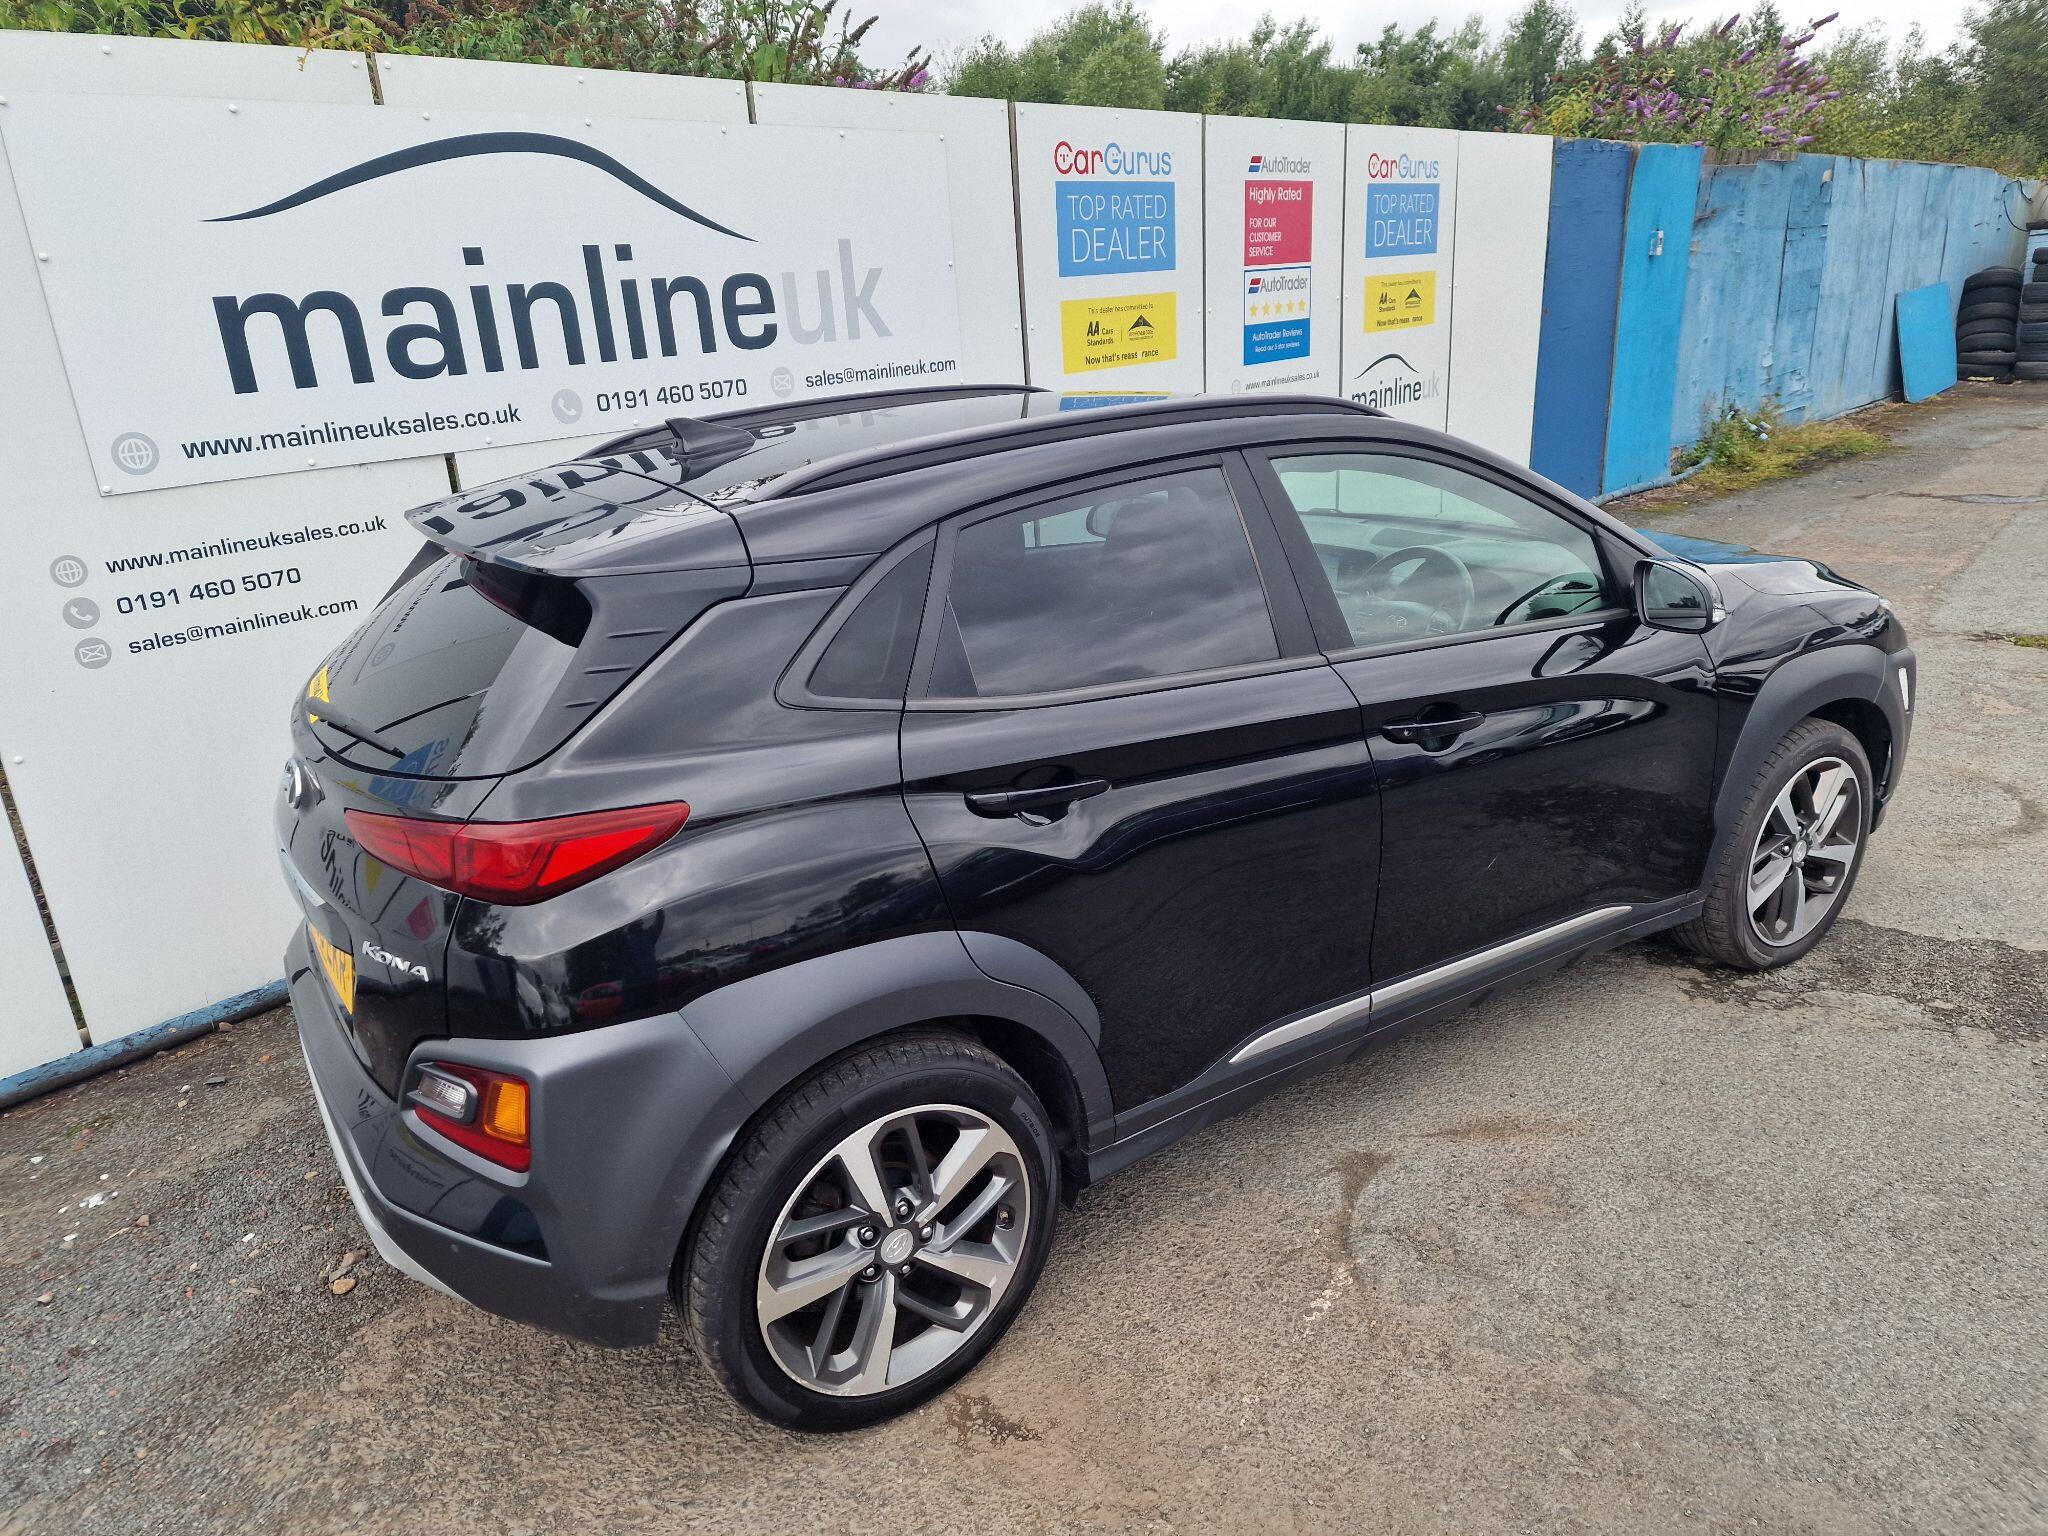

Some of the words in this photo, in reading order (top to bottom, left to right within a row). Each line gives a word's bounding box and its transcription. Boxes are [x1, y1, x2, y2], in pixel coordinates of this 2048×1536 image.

[1054, 140, 1172, 176] CarGurus
[1261, 156, 1312, 174] AutoTrader
[1368, 153, 1440, 179] CarGurus
[1067, 194, 1106, 220] TOP
[1111, 194, 1167, 220] RATED
[1249, 186, 1276, 204] Highly
[1278, 186, 1302, 201] Rated
[1373, 194, 1398, 215] TOP
[1400, 193, 1435, 214] RATED
[1249, 217, 1262, 228] FOR
[1263, 217, 1277, 228] OUR
[1374, 218, 1433, 247] DEALER
[1072, 226, 1167, 263] DEALER
[1249, 231, 1282, 243] CUSTOMER
[1249, 246, 1274, 257] SERVICE
[1260, 276, 1308, 293] AutoTrader
[212, 237, 893, 394] mainlineuk
[1086, 321, 1100, 337] AA
[1087, 337, 1114, 347] Standards
[1252, 331, 1282, 342] AutoTrader
[1085, 355, 1101, 365] Now
[1101, 353, 1120, 363] that's
[805, 358, 956, 388] sales@mainlineuk.com
[1245, 369, 1320, 391] www.mainlineuksales.co.uk
[597, 388, 649, 412] 0191
[656, 382, 695, 406] 460
[699, 378, 748, 401] 5070
[181, 403, 522, 460] www.mainlineuksales.co.uk
[105, 515, 388, 574] www.mainlineuksales.co.uk
[116, 588, 181, 614] 0191
[189, 578, 236, 602] 460
[241, 567, 302, 592] 5070
[128, 598, 359, 654] sales@mainlineuk.com
[361, 940, 430, 983] KONA
